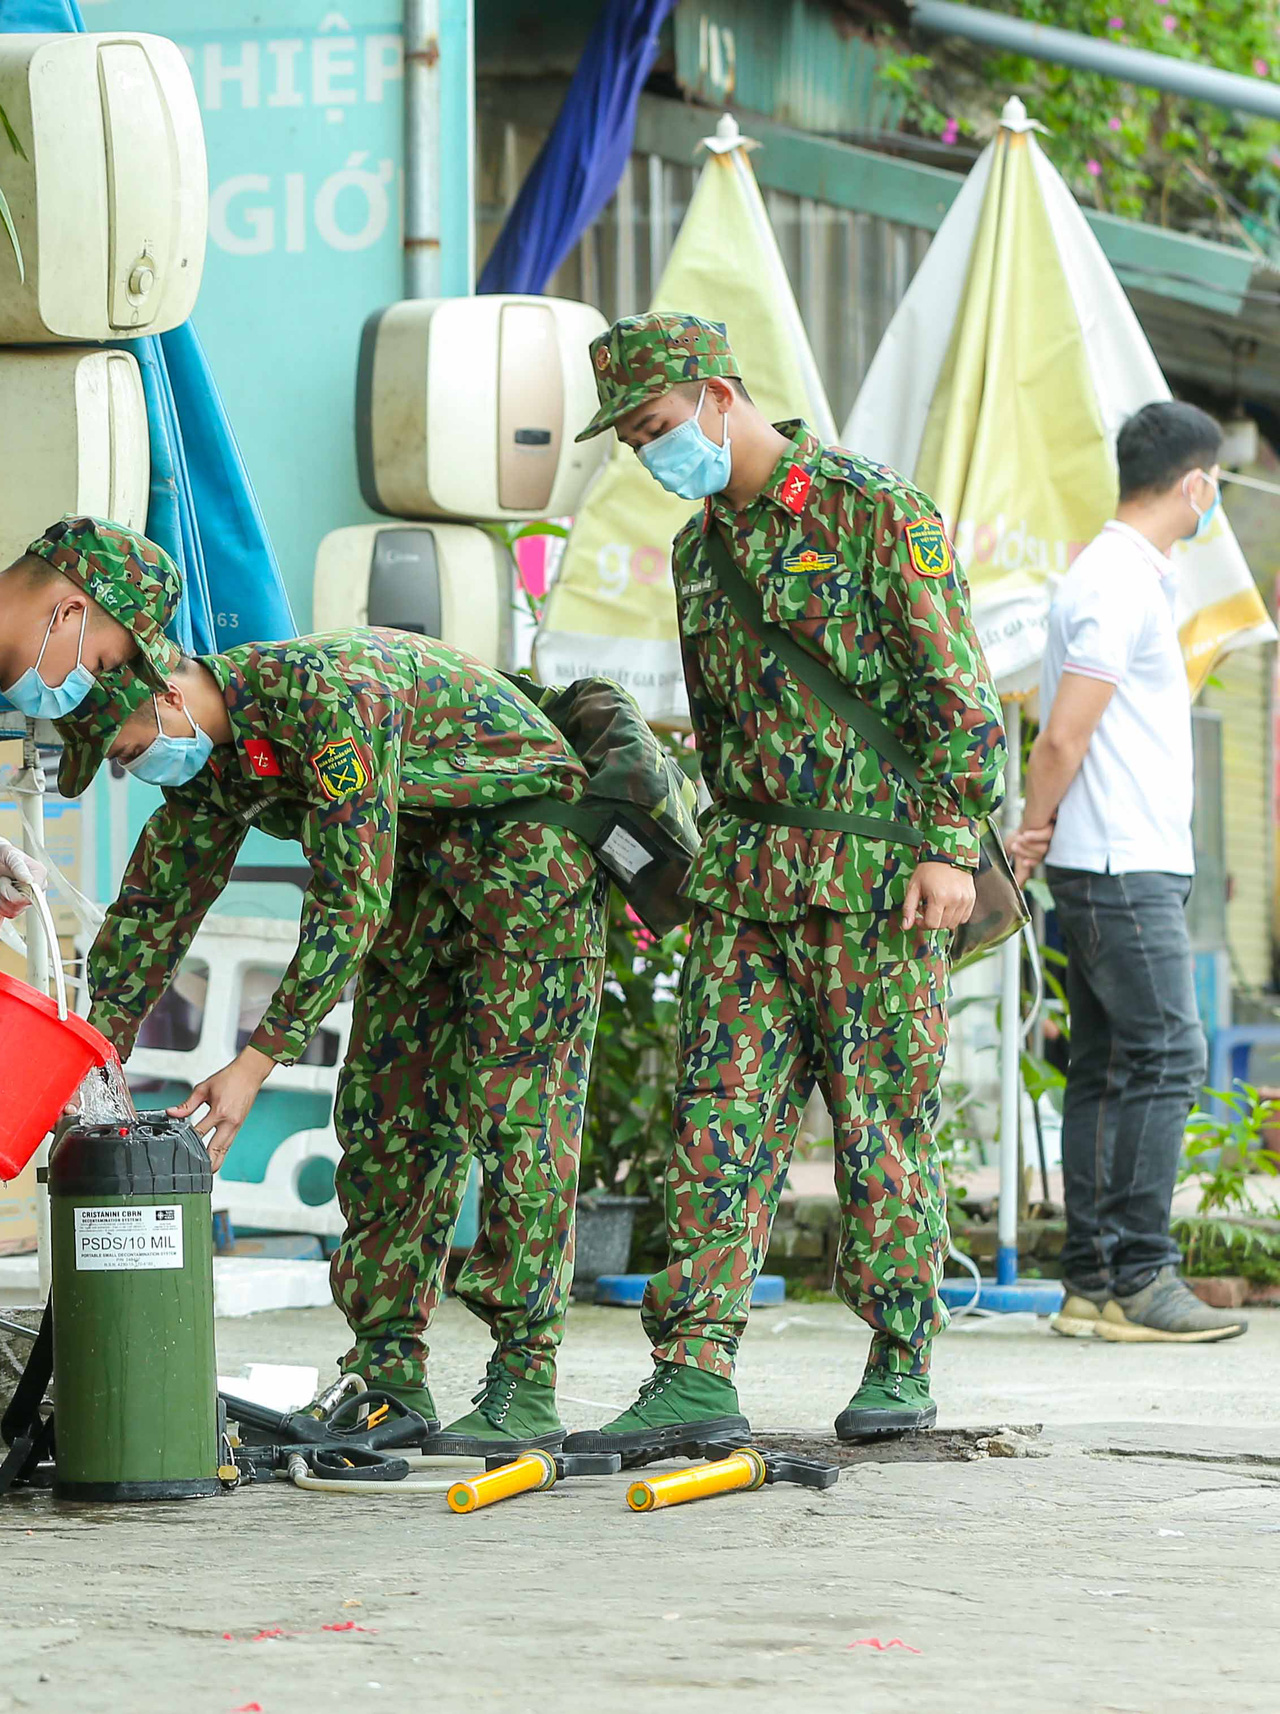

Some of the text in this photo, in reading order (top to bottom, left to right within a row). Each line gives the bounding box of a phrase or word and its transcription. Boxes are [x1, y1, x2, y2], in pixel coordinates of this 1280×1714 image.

[180, 13, 405, 124] HIỆP
[206, 150, 405, 255] GIỚ
[90, 577, 118, 606] Joker
[213, 612, 239, 628] 63
[82, 1235, 176, 1251] PSDS/10 MIL
